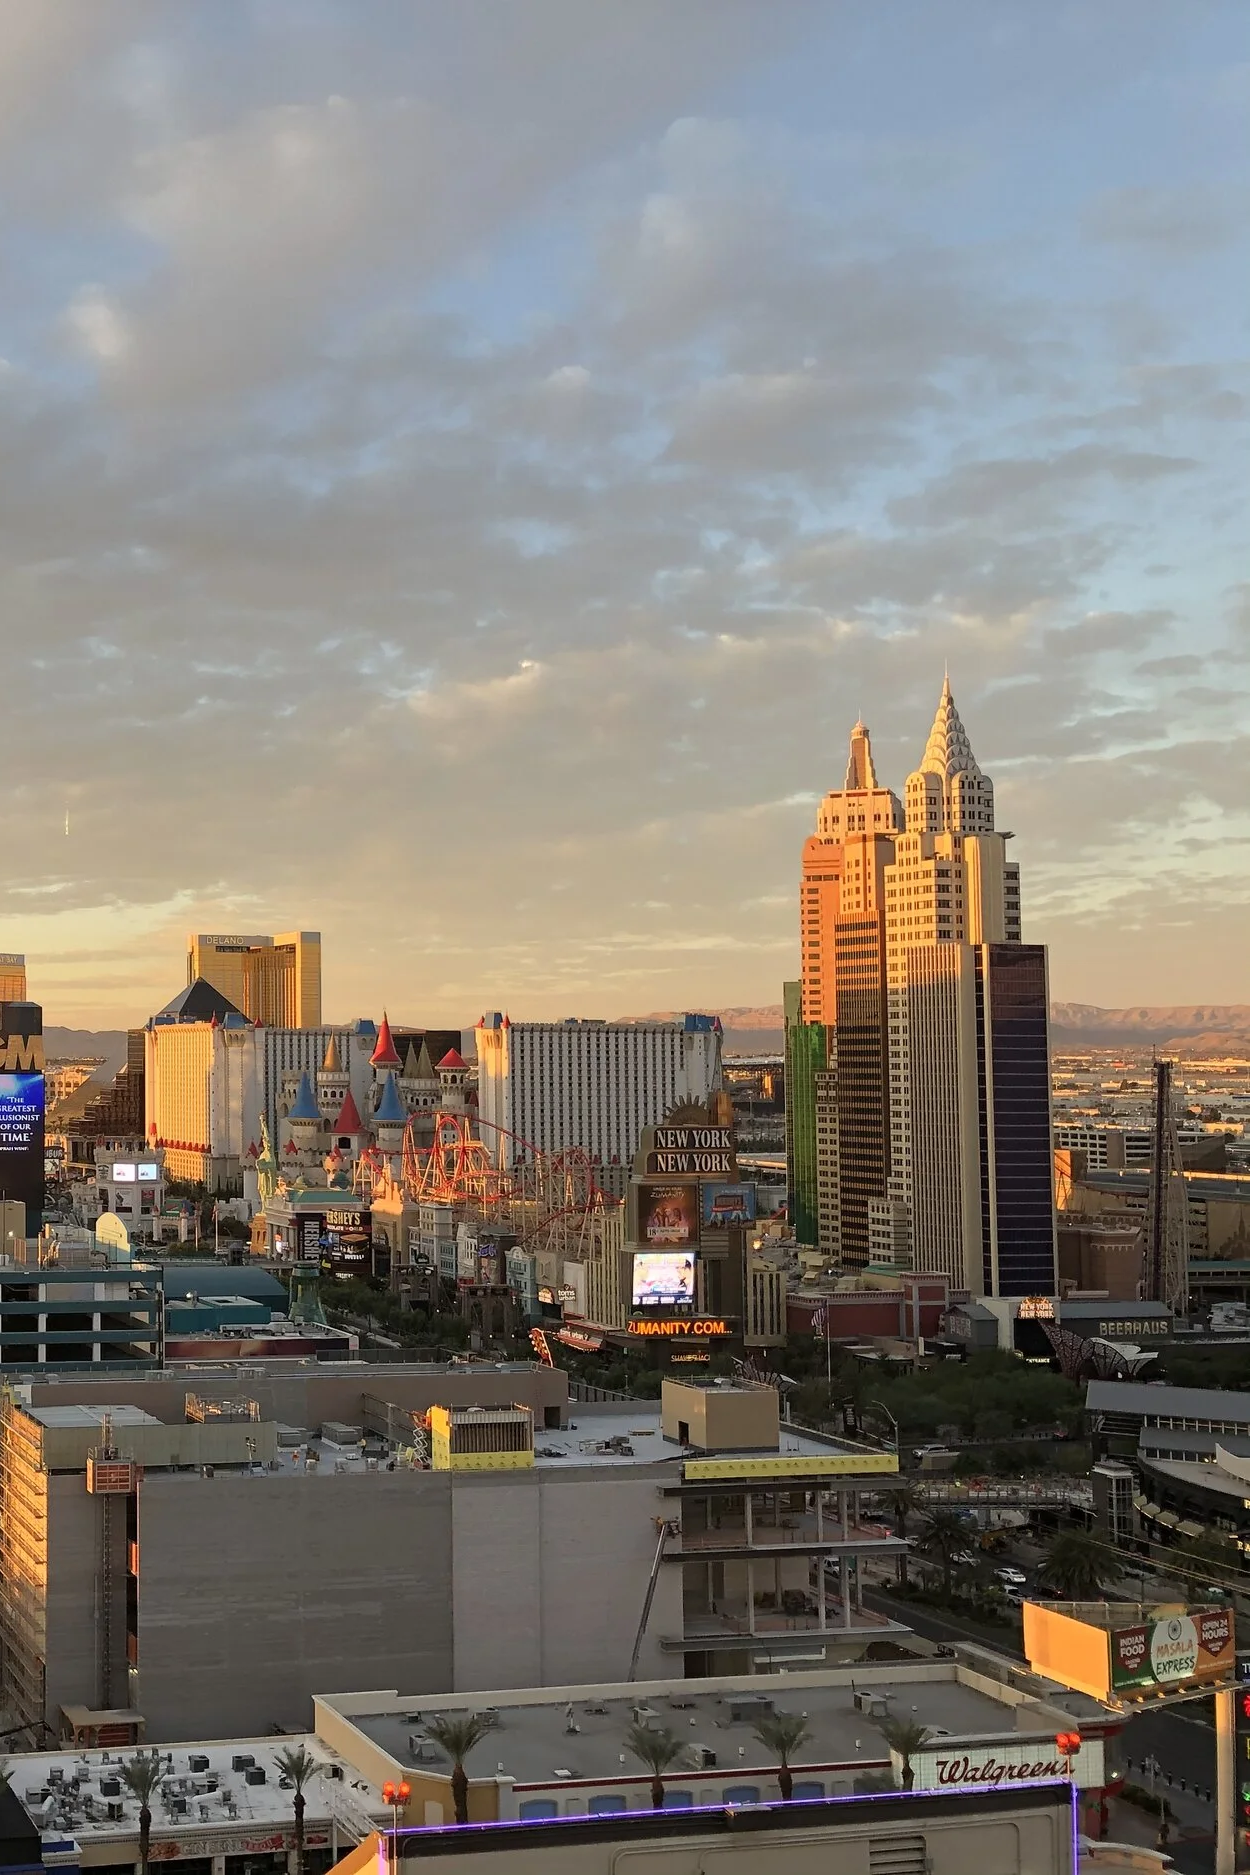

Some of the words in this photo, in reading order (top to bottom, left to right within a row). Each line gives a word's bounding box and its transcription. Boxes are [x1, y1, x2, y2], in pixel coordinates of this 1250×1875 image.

[206, 936, 244, 945] DELANO
[656, 1130, 689, 1148] NEW
[693, 1130, 731, 1148] YORK
[656, 1153, 689, 1172] NEW
[693, 1153, 732, 1172] YORK
[1020, 1302, 1036, 1310] NEW
[1036, 1302, 1054, 1310] YORK
[1020, 1310, 1036, 1318] NEW
[1036, 1310, 1055, 1318] YORK
[950, 1316, 971, 1329] BEER
[1100, 1321, 1168, 1336] BEERHAUS
[1202, 1621, 1219, 1631] OPEN
[1219, 1619, 1228, 1628] 24
[1120, 1634, 1145, 1647] INDIAN
[1202, 1628, 1229, 1640] HOURS
[1120, 1644, 1145, 1658] FOOD
[1156, 1639, 1194, 1658] MASALA
[1156, 1655, 1196, 1676] EXPRESS
[935, 1756, 1076, 1785] Walgreens
